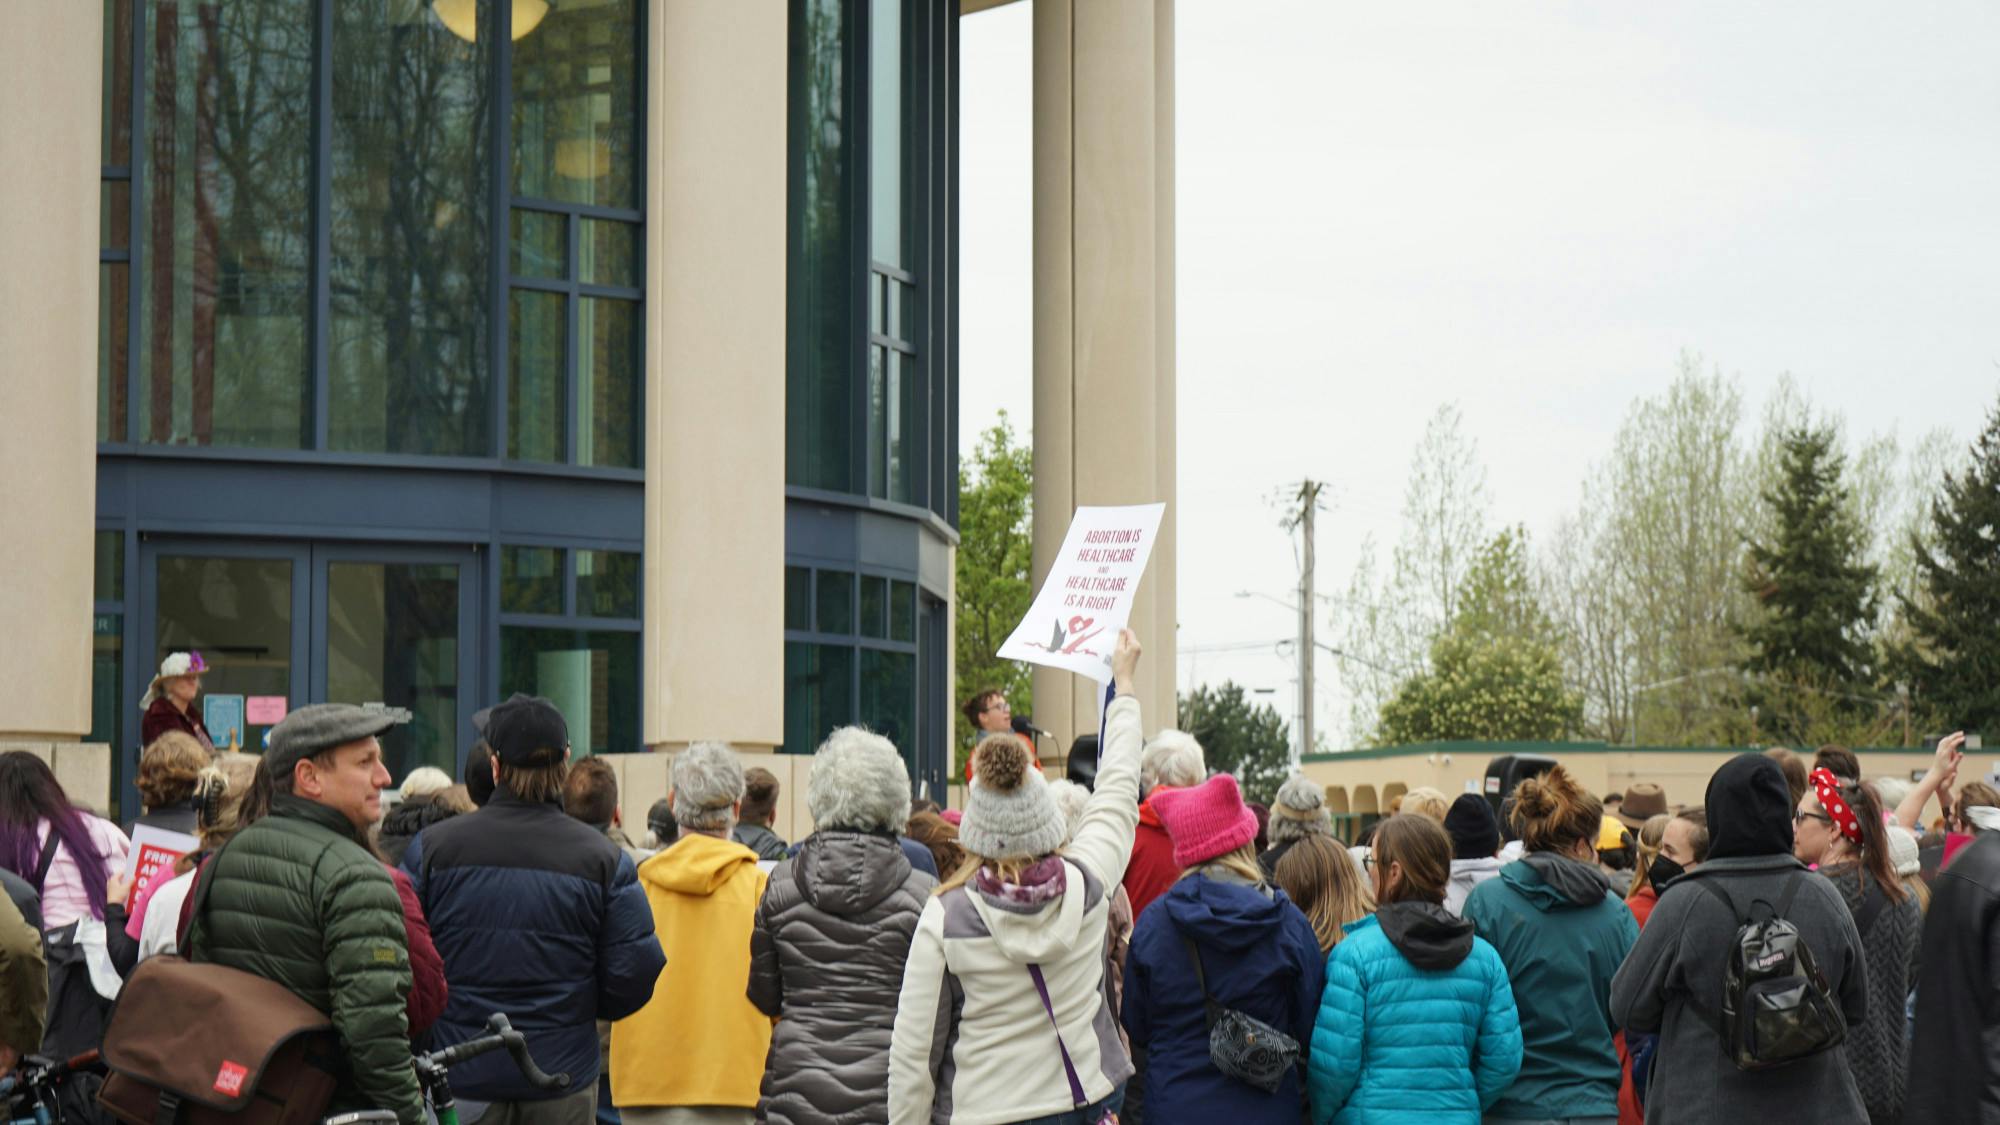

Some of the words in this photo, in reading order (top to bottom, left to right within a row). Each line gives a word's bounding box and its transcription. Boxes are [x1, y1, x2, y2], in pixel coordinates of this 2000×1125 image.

[1084, 530, 1132, 543] ABORTION
[1131, 529, 1142, 543] IS
[1077, 548, 1136, 562] HEALTHCARE
[1066, 576, 1127, 591] HEALTHCARE
[1064, 594, 1076, 607] IS
[1075, 595, 1085, 608] A
[1085, 596, 1116, 610] RIGHT
[144, 849, 175, 864] FREE
